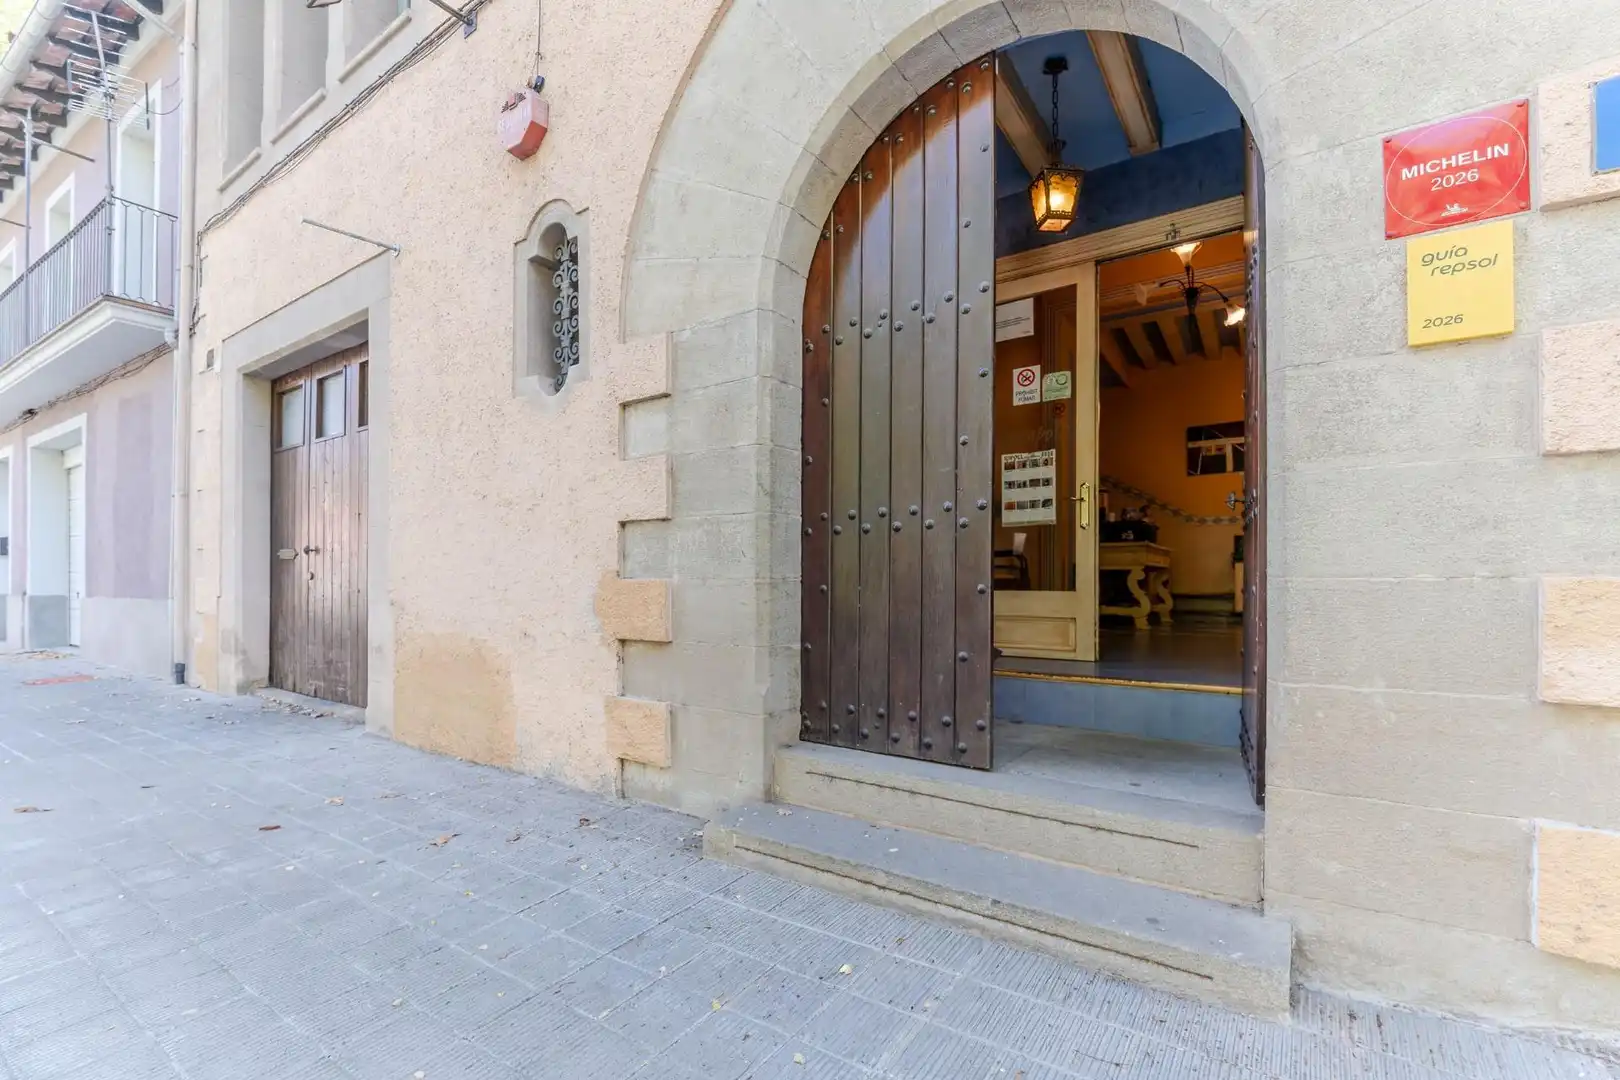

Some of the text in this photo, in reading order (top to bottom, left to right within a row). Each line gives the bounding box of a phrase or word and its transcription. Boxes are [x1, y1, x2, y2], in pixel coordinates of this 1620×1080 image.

[1401, 143, 1510, 180] MICHELIN
[1430, 169, 1479, 192] 2026
[1421, 245, 1469, 267] guía
[1430, 254, 1498, 277] repsol
[1422, 314, 1464, 329] 2026
